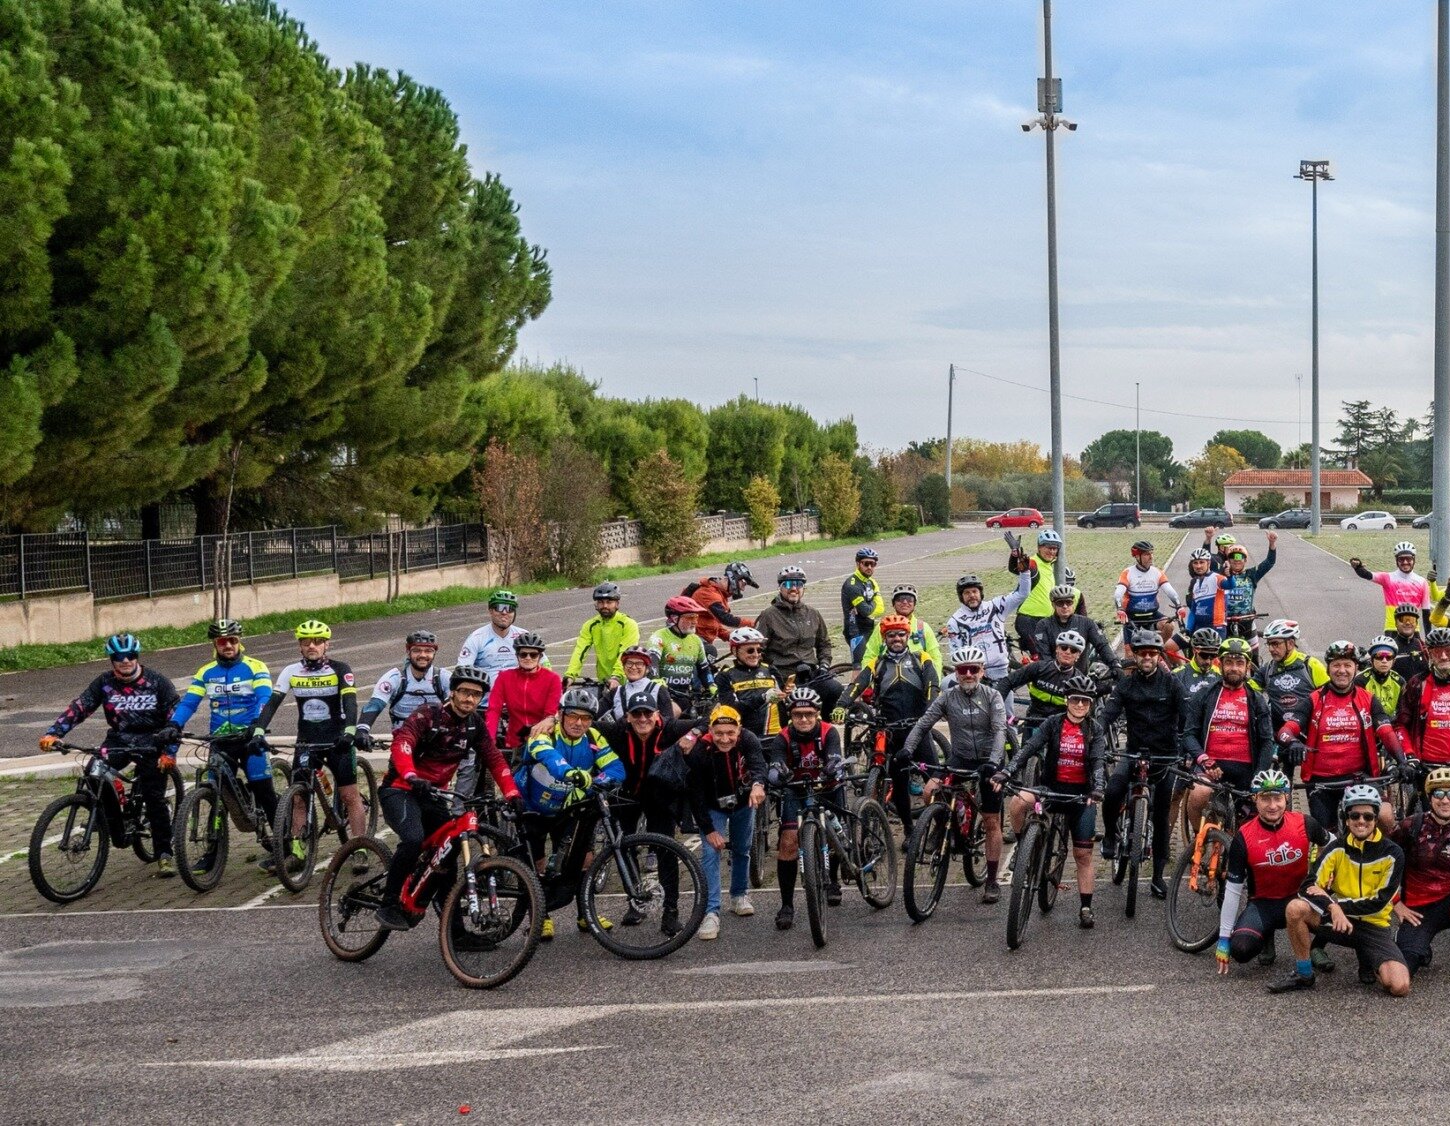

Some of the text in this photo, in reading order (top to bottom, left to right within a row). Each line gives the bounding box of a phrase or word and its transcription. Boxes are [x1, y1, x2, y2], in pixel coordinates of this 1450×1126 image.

[109, 694, 158, 703] SANTA
[115, 701, 158, 710] CRUZ
[1265, 848, 1303, 866] Talos
